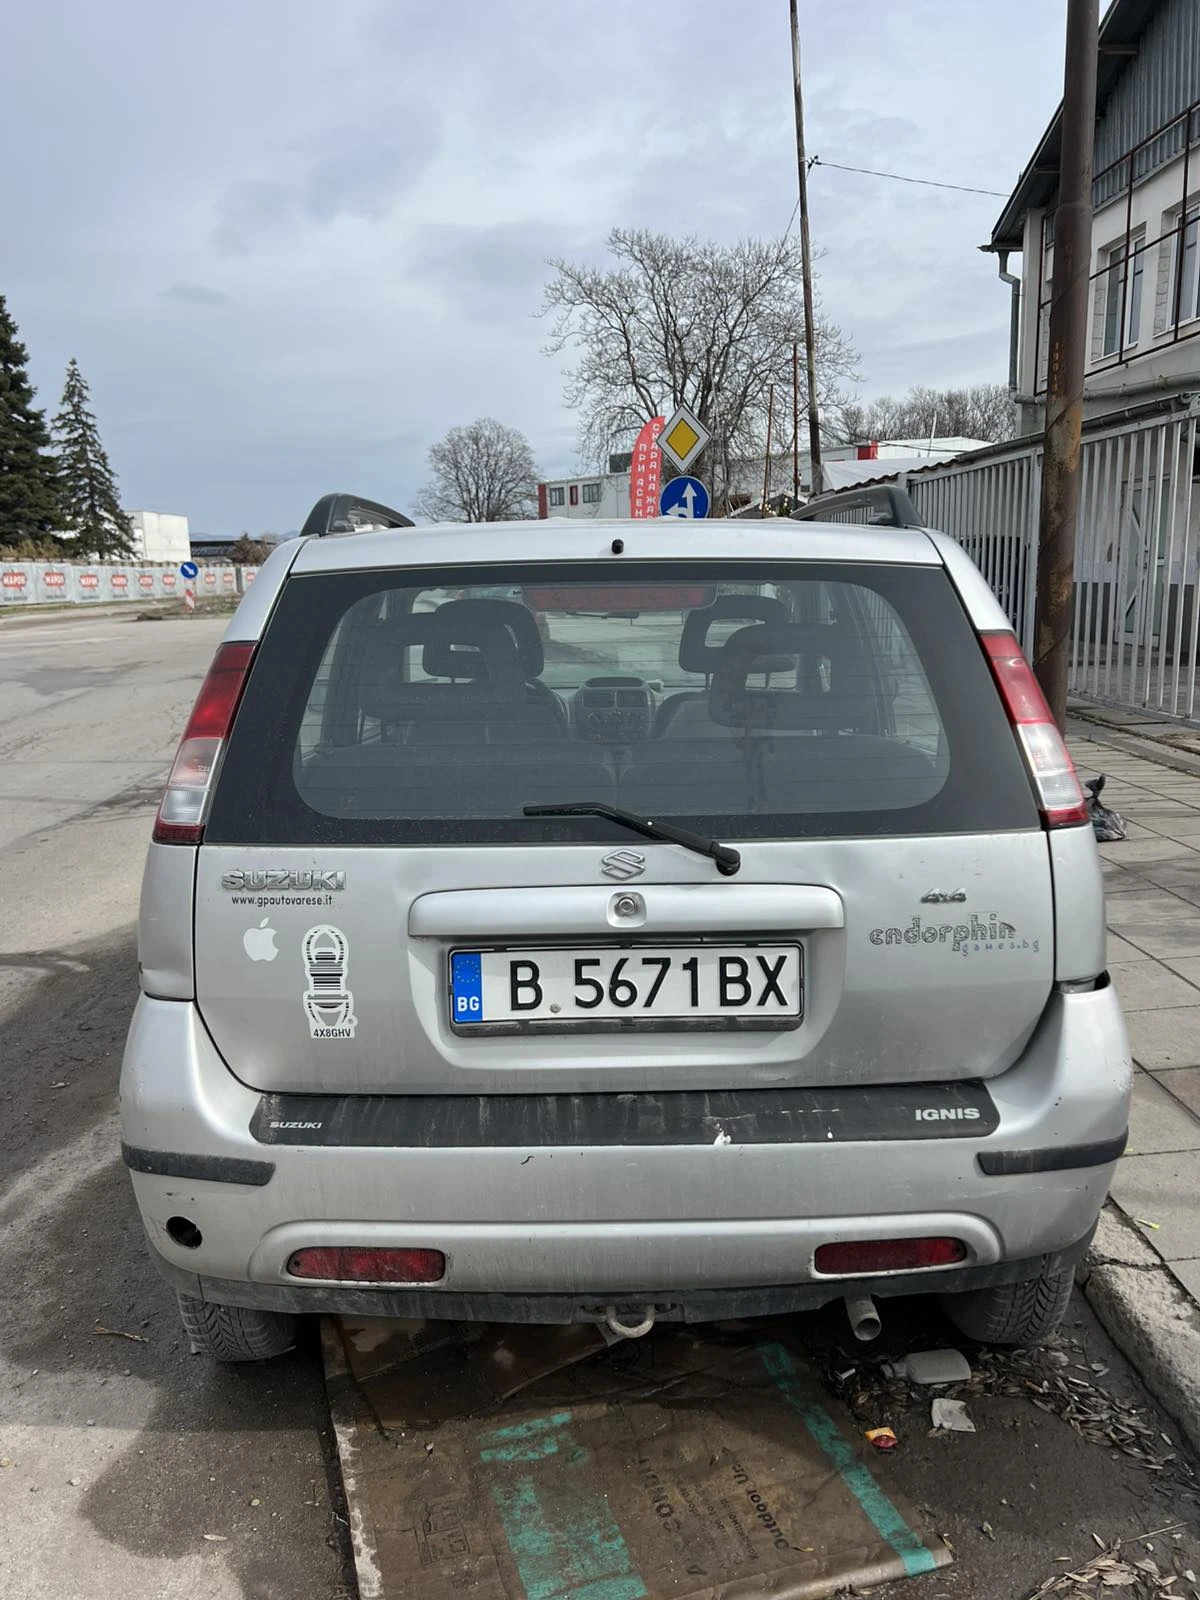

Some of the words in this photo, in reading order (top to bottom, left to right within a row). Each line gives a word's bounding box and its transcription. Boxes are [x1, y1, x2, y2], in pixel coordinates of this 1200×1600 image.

[637, 443, 648, 472] ПРИ
[221, 870, 346, 891] SUZUKI
[231, 894, 333, 908] www.gpautovarese.it
[869, 913, 1017, 951] endorphin
[510, 960, 543, 1011] B
[574, 957, 699, 1009] 5671
[718, 955, 788, 1007] BX
[457, 997, 480, 1012] BG
[313, 1028, 351, 1038] 4X8GHV
[915, 1107, 981, 1121] IGNIS
[269, 1121, 323, 1129] SUZUKI
[746, 1488, 790, 1552] Outdoor
